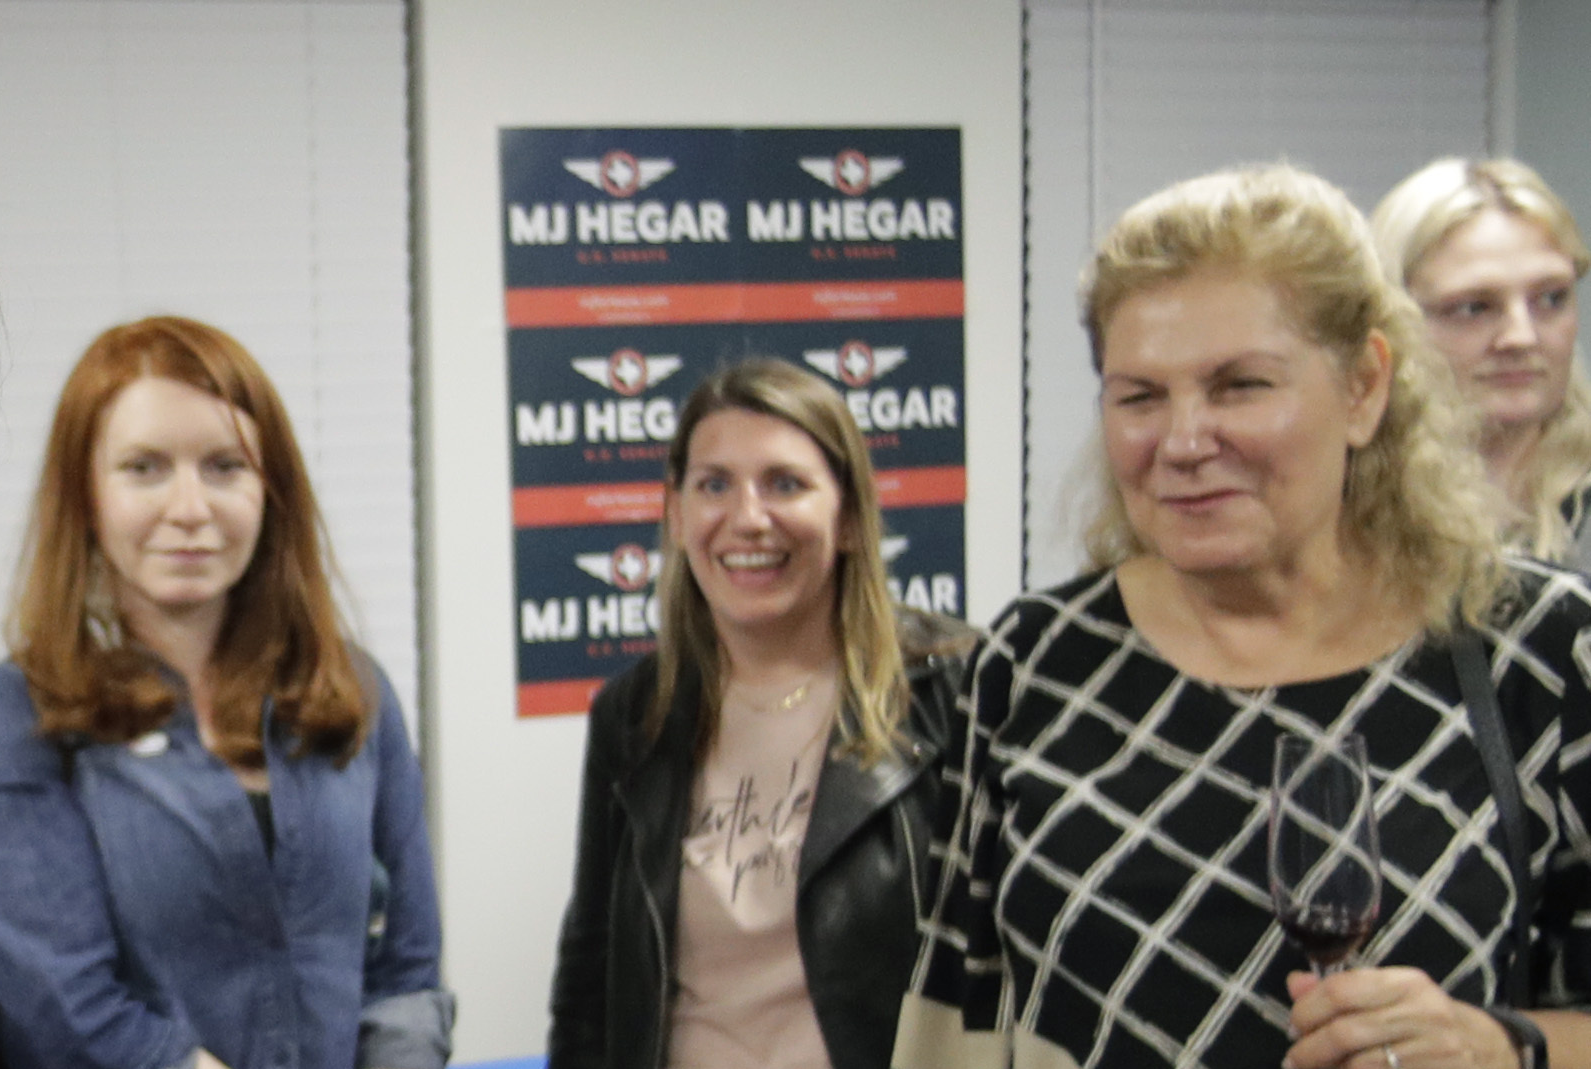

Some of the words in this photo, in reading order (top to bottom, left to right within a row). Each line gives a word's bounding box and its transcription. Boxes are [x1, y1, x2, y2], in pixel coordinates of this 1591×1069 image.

[510, 203, 570, 245] MJ
[576, 200, 730, 244] HEGAR
[747, 200, 803, 242] MJ
[811, 199, 955, 241] HEGAR
[516, 401, 578, 446] MJ
[584, 397, 678, 443] HEG
[846, 385, 958, 432] EGAR
[521, 597, 581, 643] MJ
